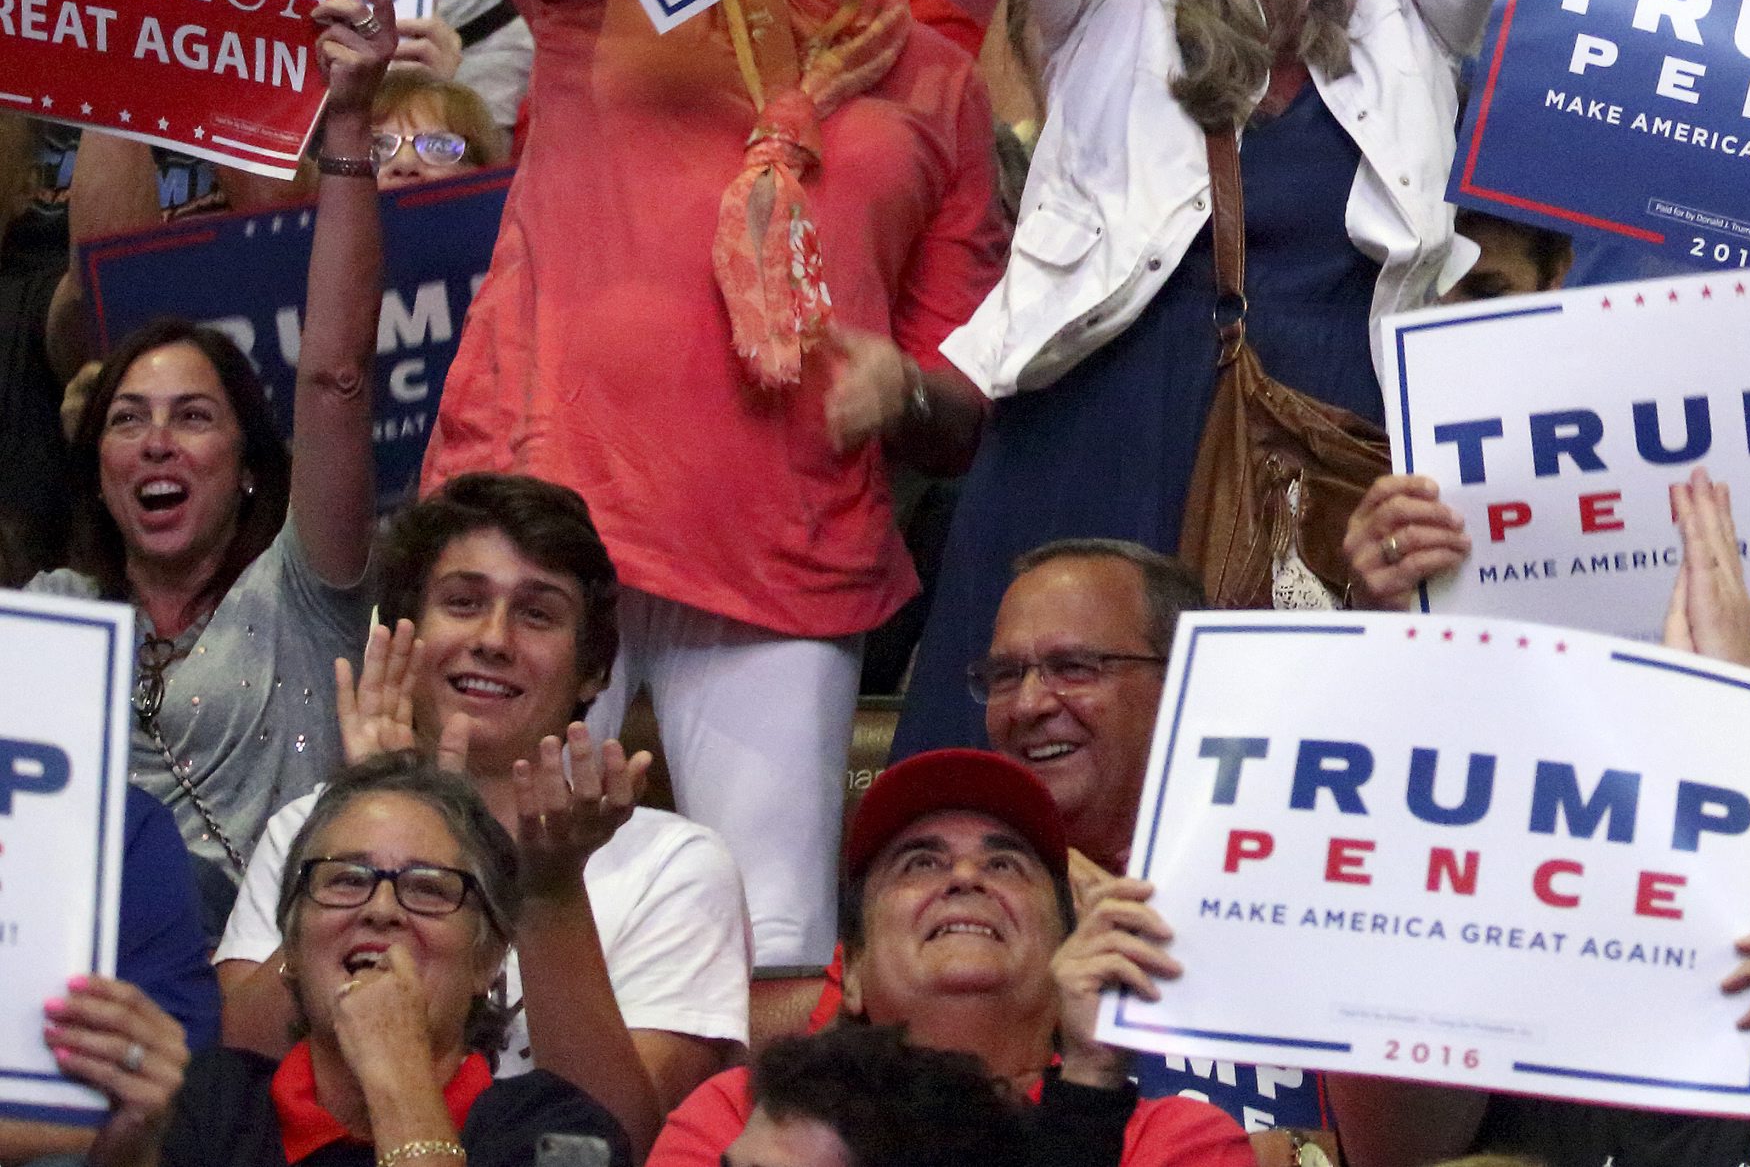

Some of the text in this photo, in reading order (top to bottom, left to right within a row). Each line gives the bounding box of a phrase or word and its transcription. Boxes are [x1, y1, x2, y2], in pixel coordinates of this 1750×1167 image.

[134, 17, 307, 92] AGAIN
[1545, 88, 1623, 126] MAKE
[1655, 203, 1673, 215] Paid
[1673, 207, 1685, 218] for
[1686, 211, 1696, 222] by
[1696, 213, 1724, 228] Donald
[1479, 553, 1558, 584] MAKE
[1570, 550, 1680, 576] AMERIC
[1223, 828, 1689, 920] PENCE
[1199, 898, 1697, 970] MAKE AMERICA GREAT AGAIN!
[1385, 1040, 1479, 1069] 2016
